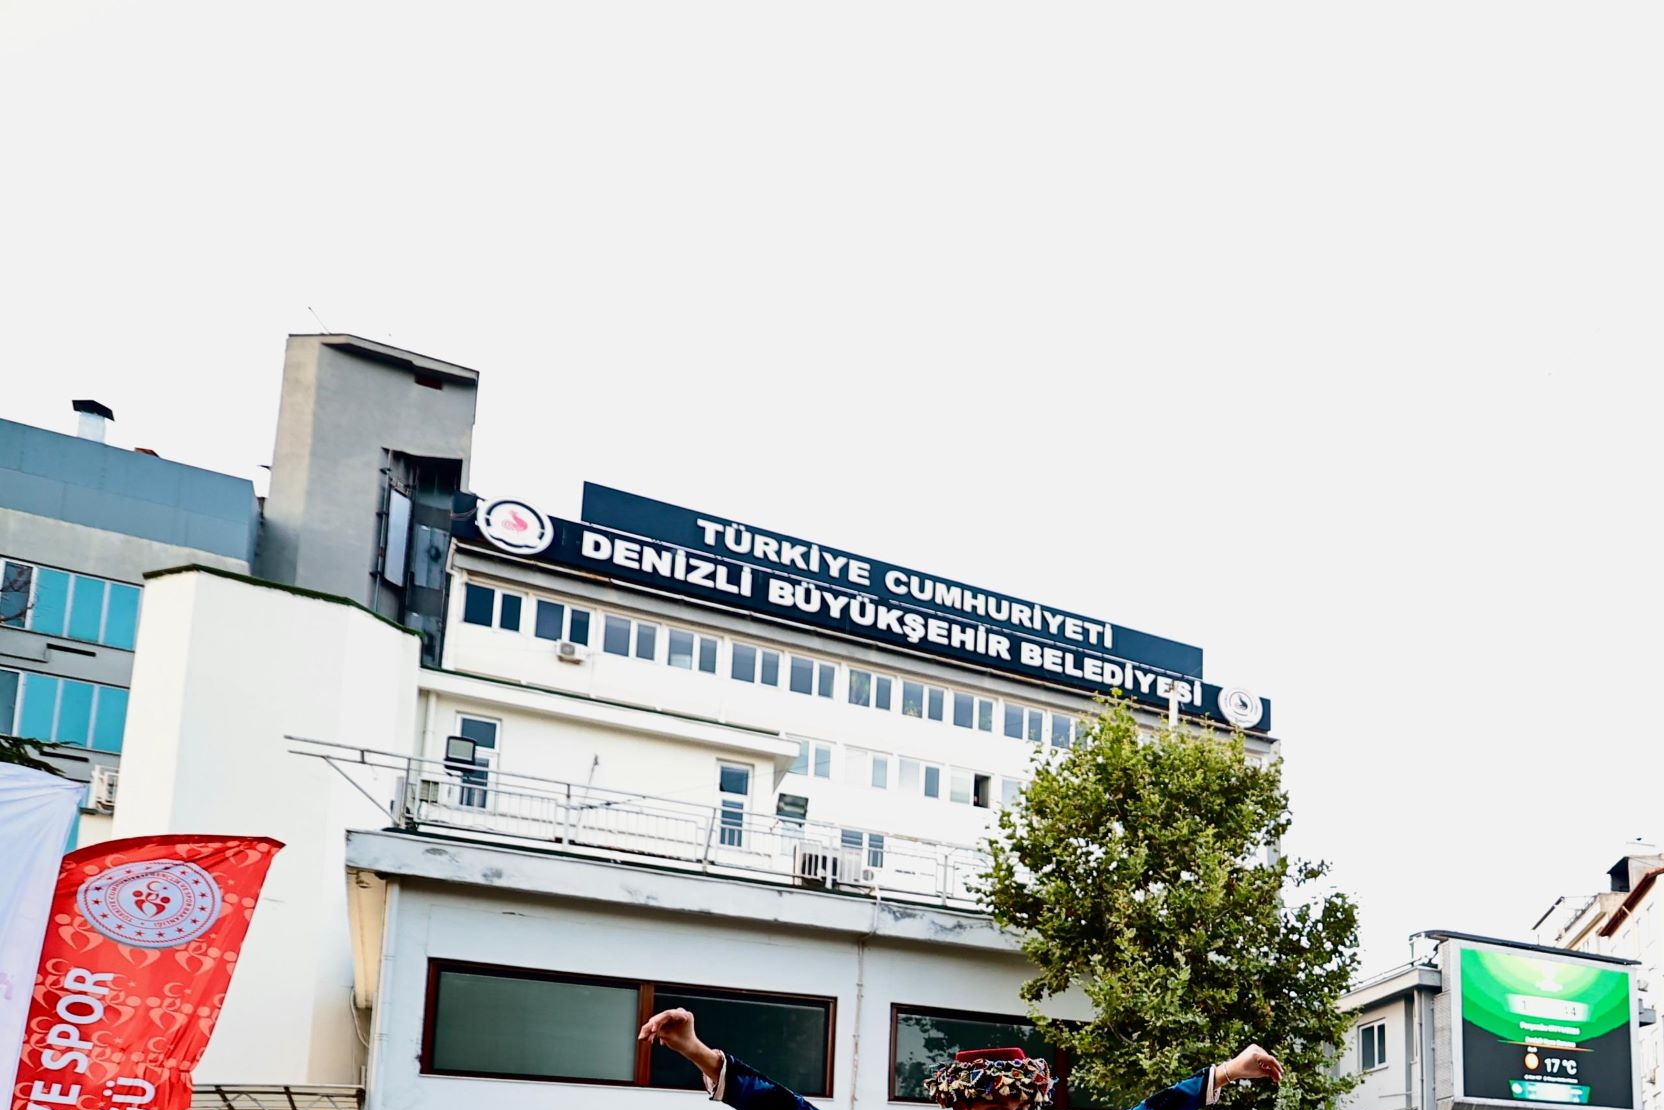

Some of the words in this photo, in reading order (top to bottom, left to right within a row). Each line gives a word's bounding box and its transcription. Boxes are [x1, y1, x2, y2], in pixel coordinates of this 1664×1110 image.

[580, 530, 752, 597] DENİZLİ
[767, 577, 1011, 661] BÜYÜKŞEHİR
[1020, 640, 1203, 707] BELEDİYESİ
[697, 518, 871, 586] TÜRKİYE
[884, 569, 1113, 649] CUMHURİYETİ
[41, 967, 115, 1075] SPOR
